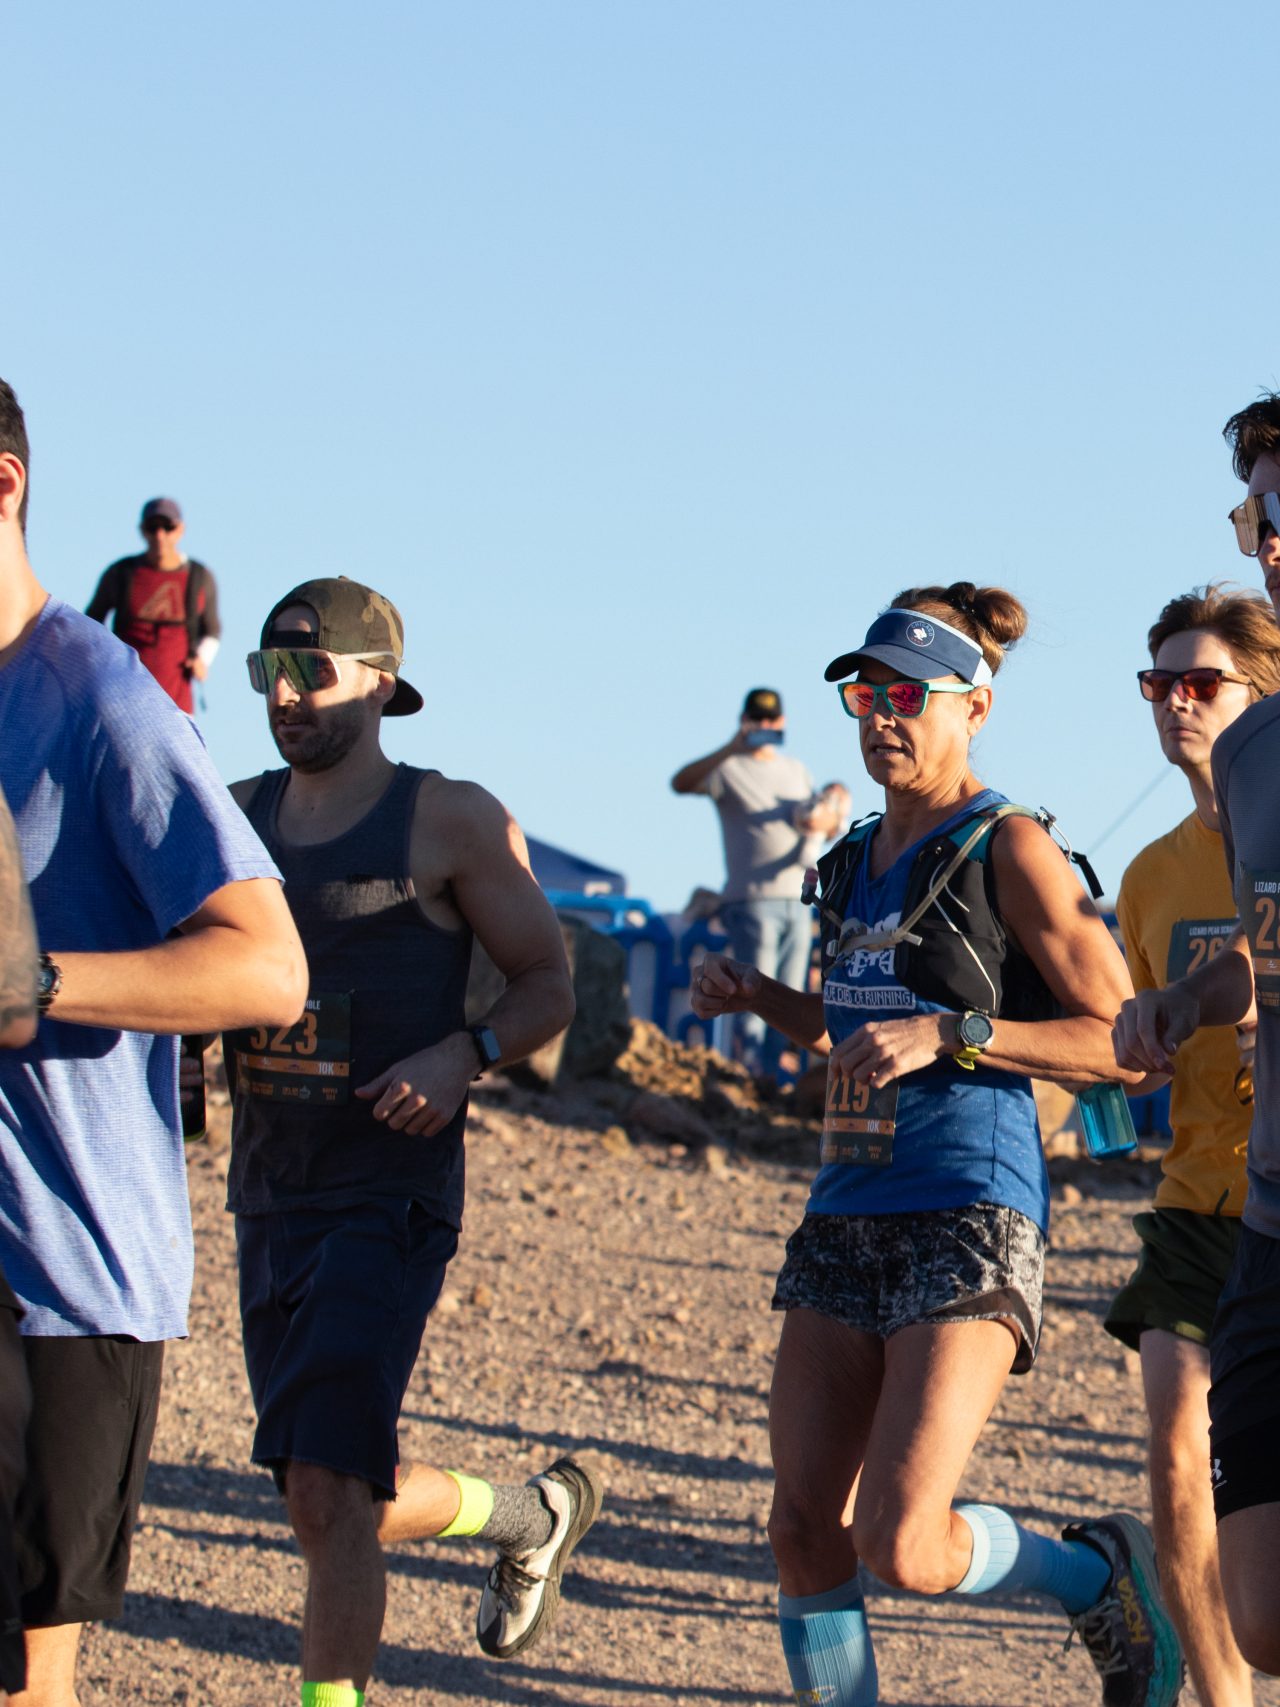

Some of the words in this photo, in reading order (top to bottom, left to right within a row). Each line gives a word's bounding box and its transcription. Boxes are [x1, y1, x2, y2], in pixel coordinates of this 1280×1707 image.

[1254, 881, 1277, 893] LIZARD
[1189, 926, 1207, 936] LIZARD
[864, 990, 911, 1006] RUNNING
[318, 1062, 334, 1075] 10K
[826, 1076, 870, 1113] 215
[866, 1120, 880, 1133] 10K
[1117, 1575, 1151, 1644] HOKA
